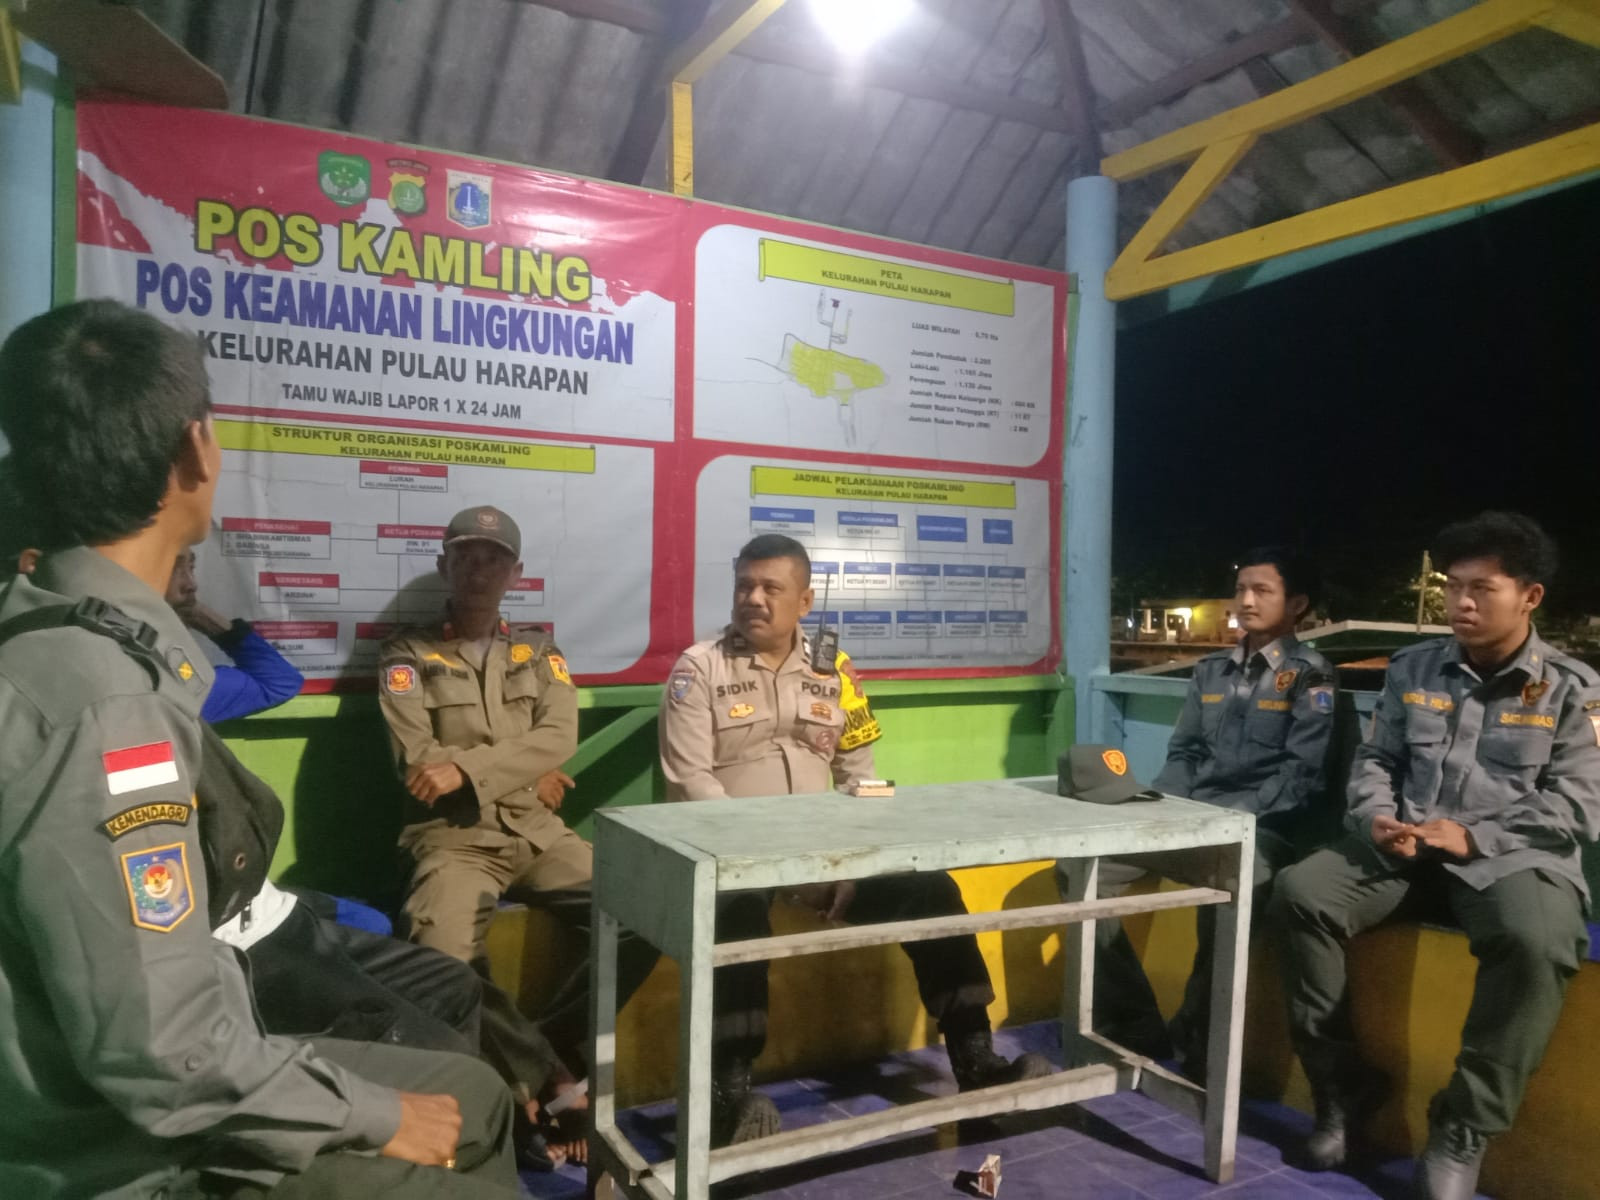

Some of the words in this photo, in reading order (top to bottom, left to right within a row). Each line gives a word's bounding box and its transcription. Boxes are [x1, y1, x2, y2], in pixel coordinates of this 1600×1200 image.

[195, 200, 322, 266] POS
[338, 222, 592, 303] KAMLING
[821, 270, 878, 288] KELURAHAN
[879, 278, 909, 292] PULAU
[910, 285, 952, 299] HARAPAN
[880, 269, 903, 280] PETA
[136, 259, 213, 317] POS
[225, 271, 423, 346] KEAMANAN
[434, 297, 634, 365] LINGKUNGAN
[199, 331, 372, 374] KELURAHAN
[382, 349, 467, 384] PULAU
[476, 361, 589, 395] HARAPAN
[282, 383, 329, 404] TAMU
[332, 386, 382, 408] WAJIB
[387, 391, 439, 413] LAPOR
[444, 397, 452, 414] 1
[456, 398, 468, 415] X
[472, 399, 488, 417] 24
[492, 401, 521, 420] JAM
[272, 426, 355, 443] STRUKTUR
[356, 430, 443, 450] ORGANISASI
[444, 438, 531, 457] POSKAMLING
[340, 445, 413, 460] KELURAHAN
[414, 450, 453, 464] PULAU
[454, 453, 507, 466] HARAPAN
[792, 472, 833, 485] JADWAL
[834, 475, 904, 491] PELAKSANAAN
[904, 480, 965, 494] POSKAMLING
[835, 488, 884, 500] KELURAHAN
[885, 490, 912, 501] PULAU
[716, 680, 759, 699] SIDIK
[108, 806, 188, 835] KEMENDAGRI
